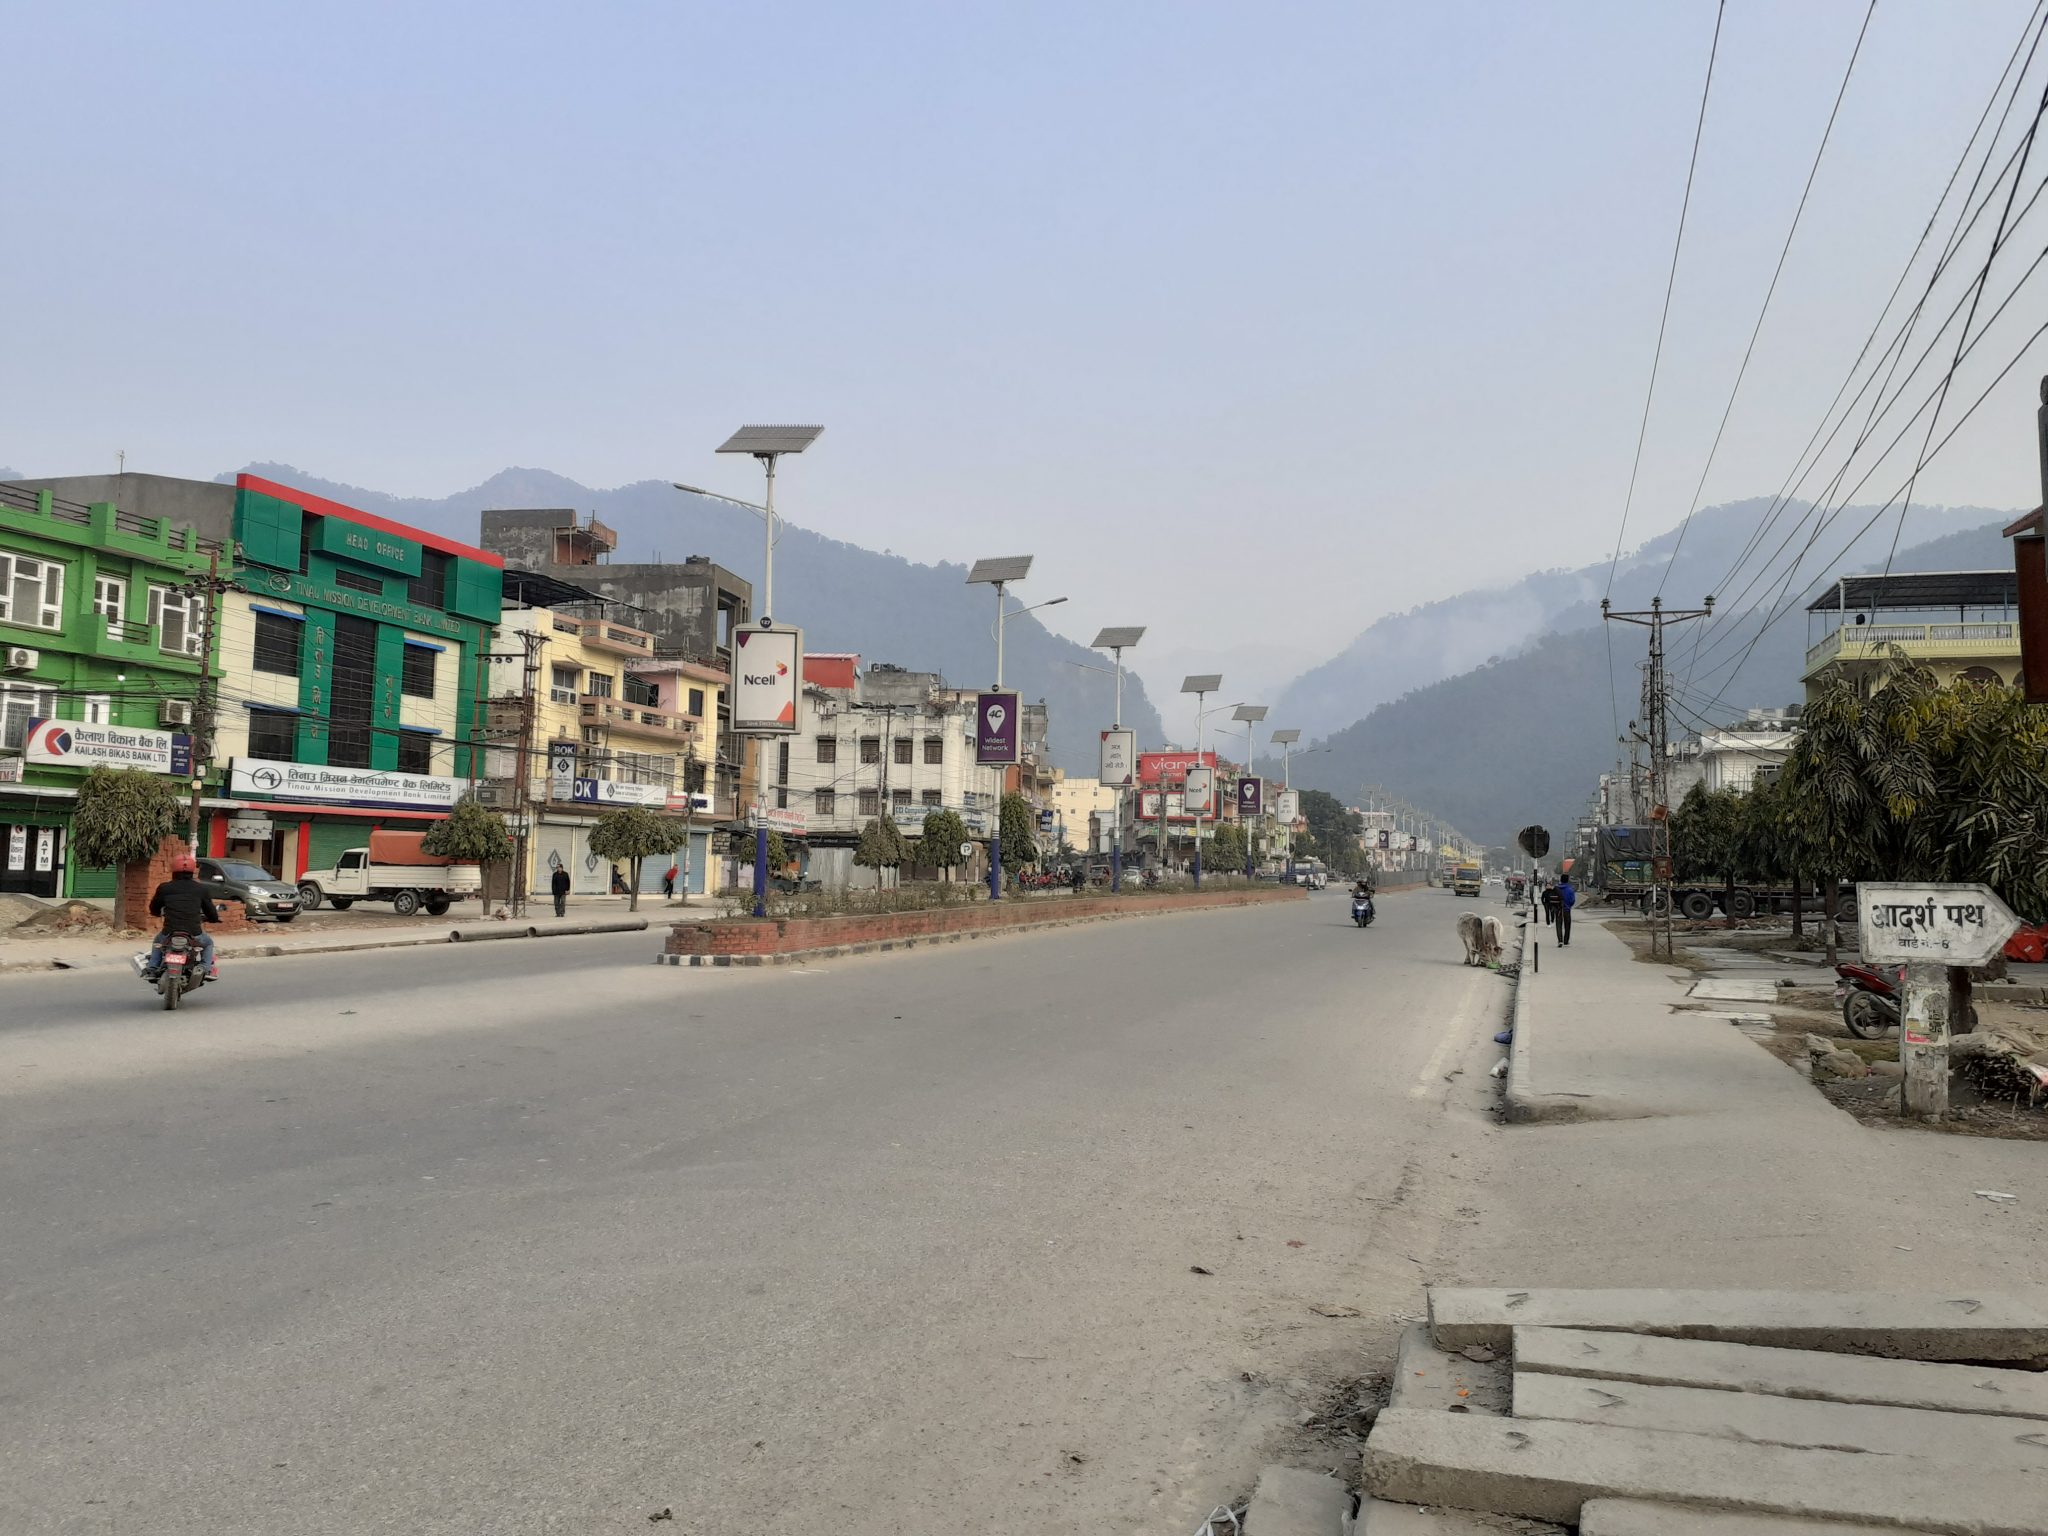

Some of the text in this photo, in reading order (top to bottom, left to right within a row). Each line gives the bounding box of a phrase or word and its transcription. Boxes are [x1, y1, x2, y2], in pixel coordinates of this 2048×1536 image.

[346, 534, 405, 562] HEAD OFFICE
[323, 588, 354, 608] MISSION
[357, 597, 410, 621] DEVELOPMENT
[412, 612, 432, 627] BANK
[435, 619, 461, 634] LIMITED
[744, 674, 775, 685] Ncell
[75, 727, 105, 743] कैलाश
[108, 731, 136, 747] विकास
[75, 746, 106, 757] KAILASH
[108, 748, 131, 759] BIKAS
[132, 751, 152, 761] BANK
[153, 753, 168, 763] LTD.
[554, 745, 574, 755] BOK
[1150, 757, 1205, 770] vian
[288, 768, 316, 782] तिनाउ
[320, 771, 347, 784] मिसन
[419, 778, 451, 792] लिमिटेड
[574, 780, 592, 798] OK
[288, 782, 311, 791] Tinau
[314, 783, 346, 793] Mission
[349, 787, 400, 797] Development
[403, 791, 421, 799] Bank
[40, 840, 49, 863] ATM
[1871, 896, 1986, 933] आदर्श पथ
[1898, 936, 1919, 949] वार्ड
